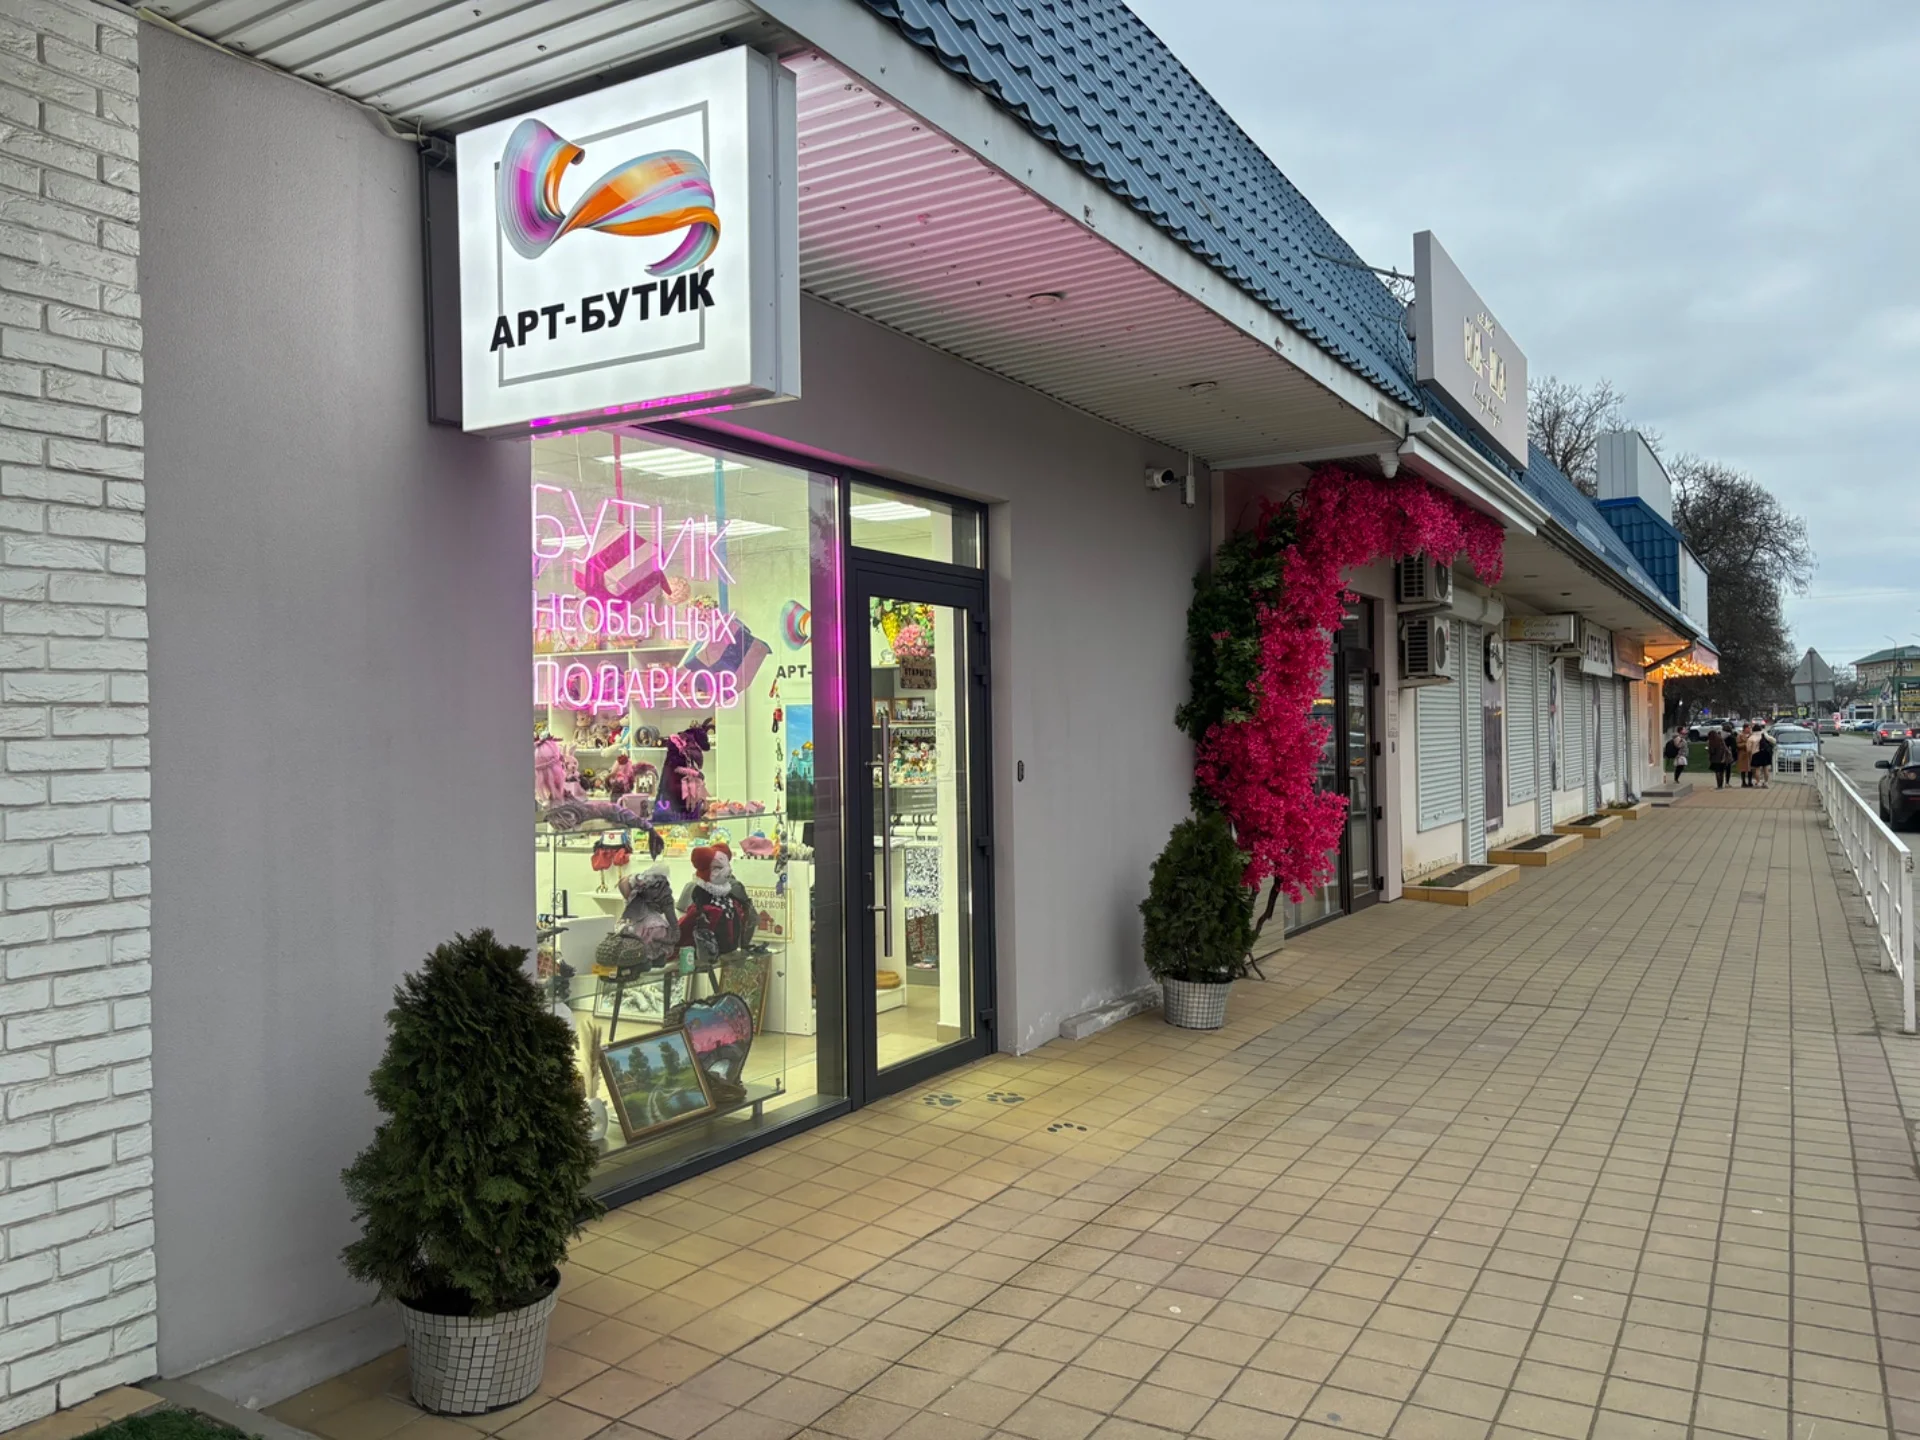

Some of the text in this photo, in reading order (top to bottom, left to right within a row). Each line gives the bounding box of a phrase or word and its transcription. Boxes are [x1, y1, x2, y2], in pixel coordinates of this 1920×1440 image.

[490, 268, 716, 352] АРТ-БУТИК
[531, 483, 736, 585] БУТИК
[531, 590, 737, 645] НЕОБЫЧНЫХ
[532, 660, 740, 716] ПОДАРКОВ
